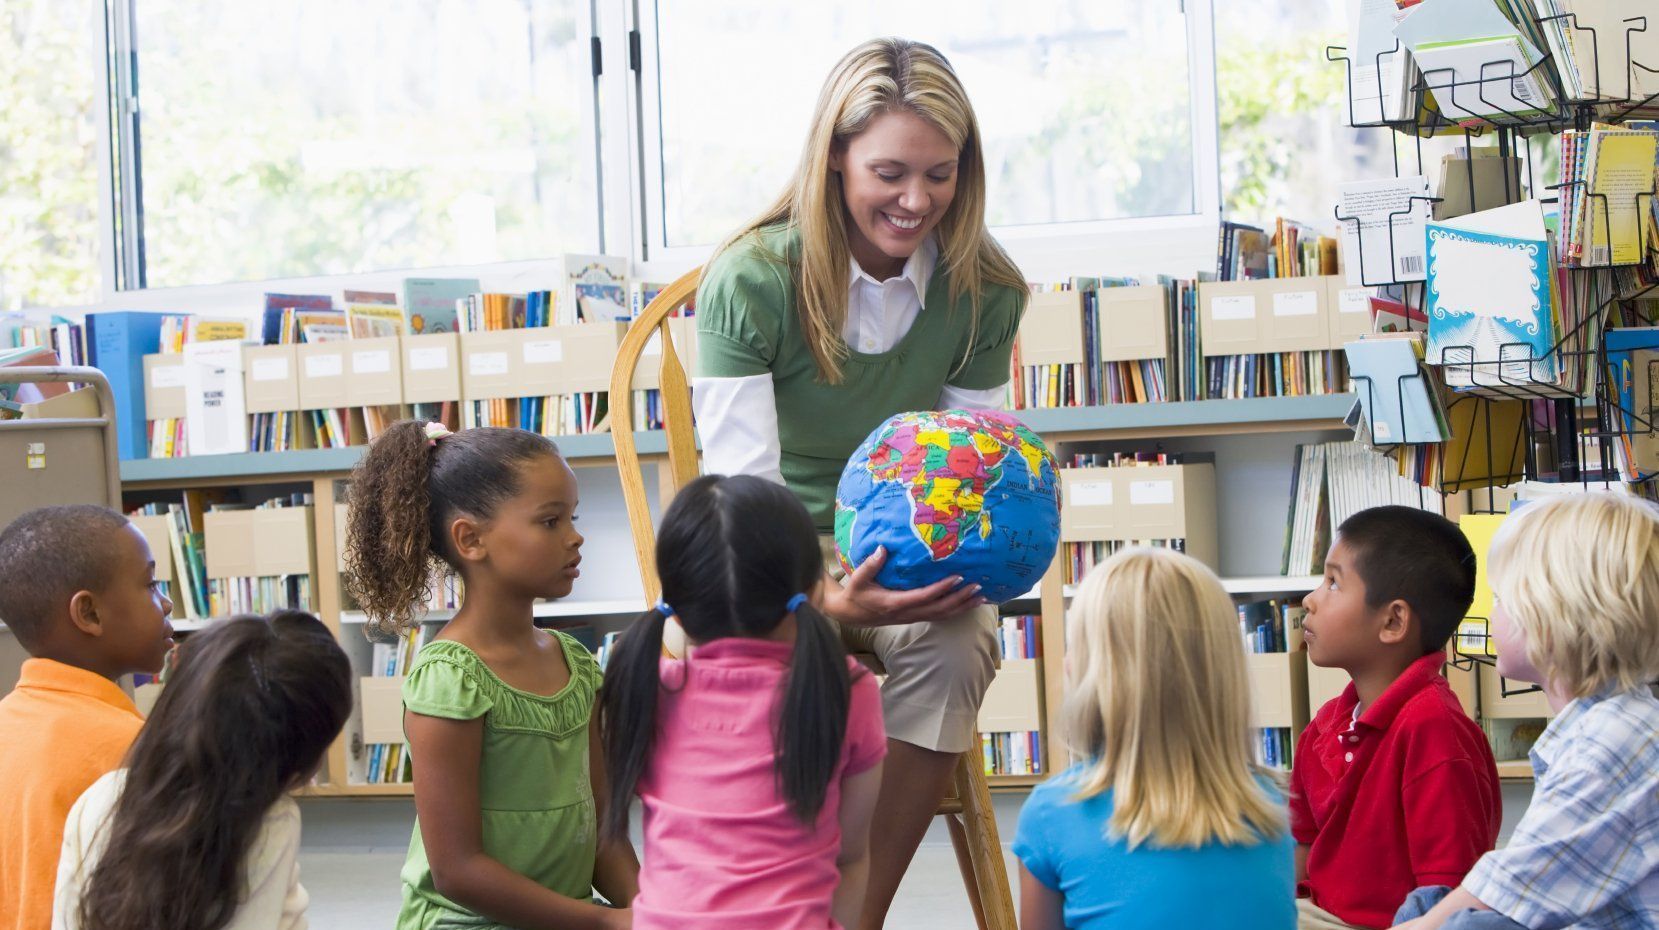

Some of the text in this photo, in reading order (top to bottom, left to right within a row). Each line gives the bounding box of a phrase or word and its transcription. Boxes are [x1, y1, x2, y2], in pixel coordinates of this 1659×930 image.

[203, 390, 224, 399] READING
[204, 399, 221, 407] POWER
[1007, 480, 1052, 496] INDIAN OCEAN
